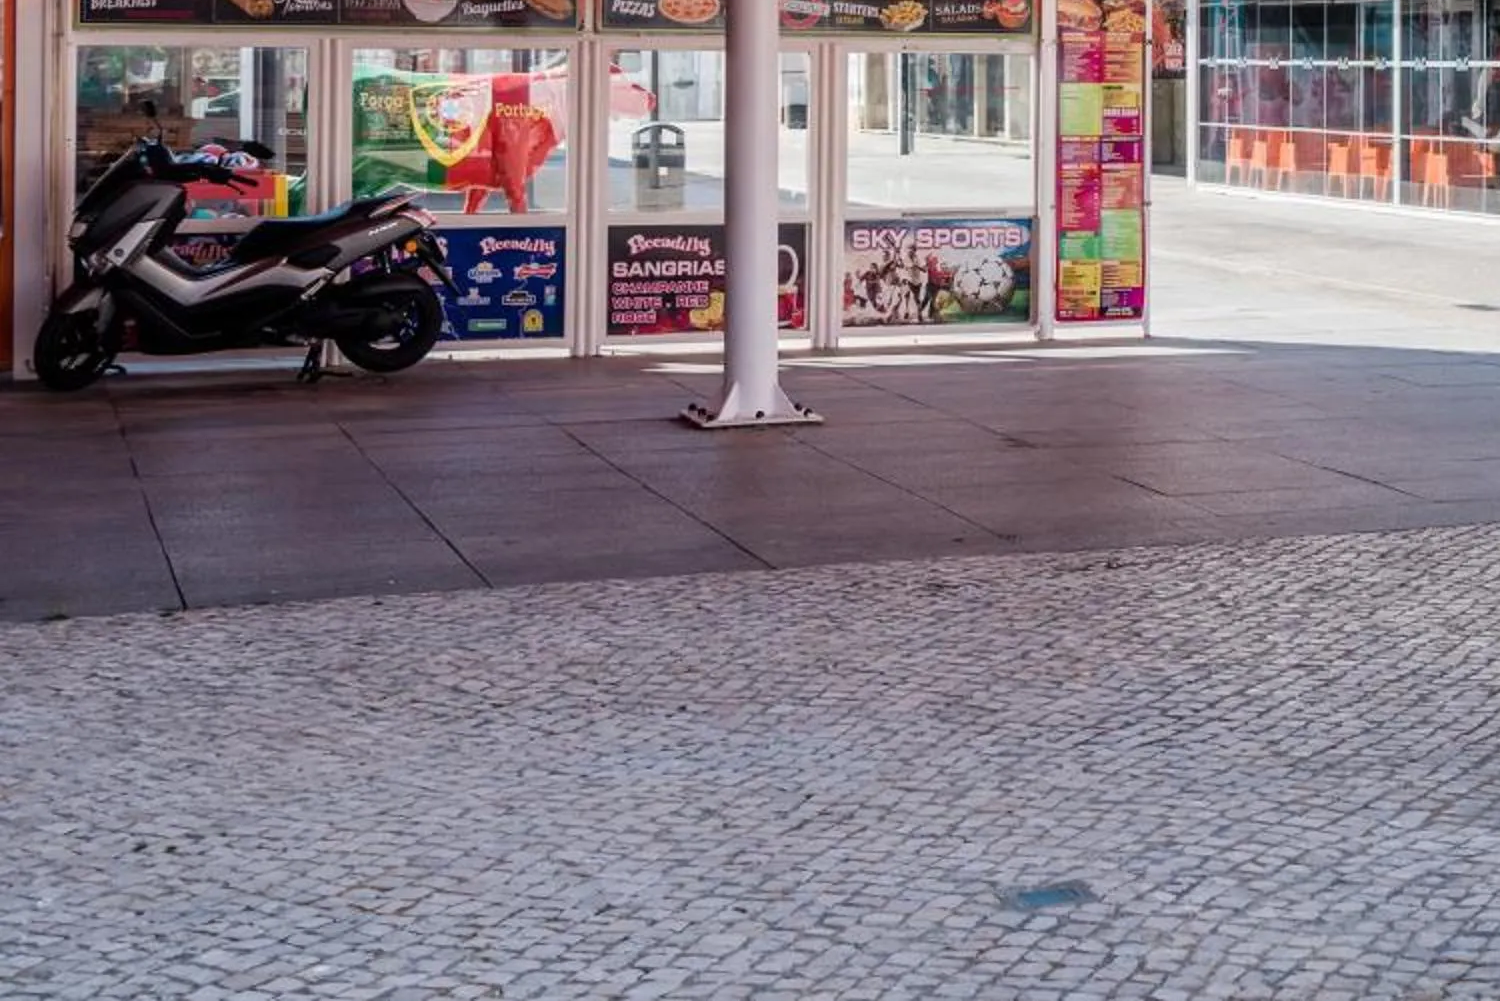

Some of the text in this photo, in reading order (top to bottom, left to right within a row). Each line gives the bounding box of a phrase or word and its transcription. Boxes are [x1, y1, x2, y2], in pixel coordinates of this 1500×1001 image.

[461, 0, 526, 17] Baguettes
[612, 0, 655, 17] PIZZAS
[935, 2, 982, 16] SALADS
[480, 236, 556, 256] Piccadilly
[627, 234, 712, 257] Piccadilly
[853, 227, 1023, 249] SKY SPORTS
[613, 260, 725, 277] SANGRIAS
